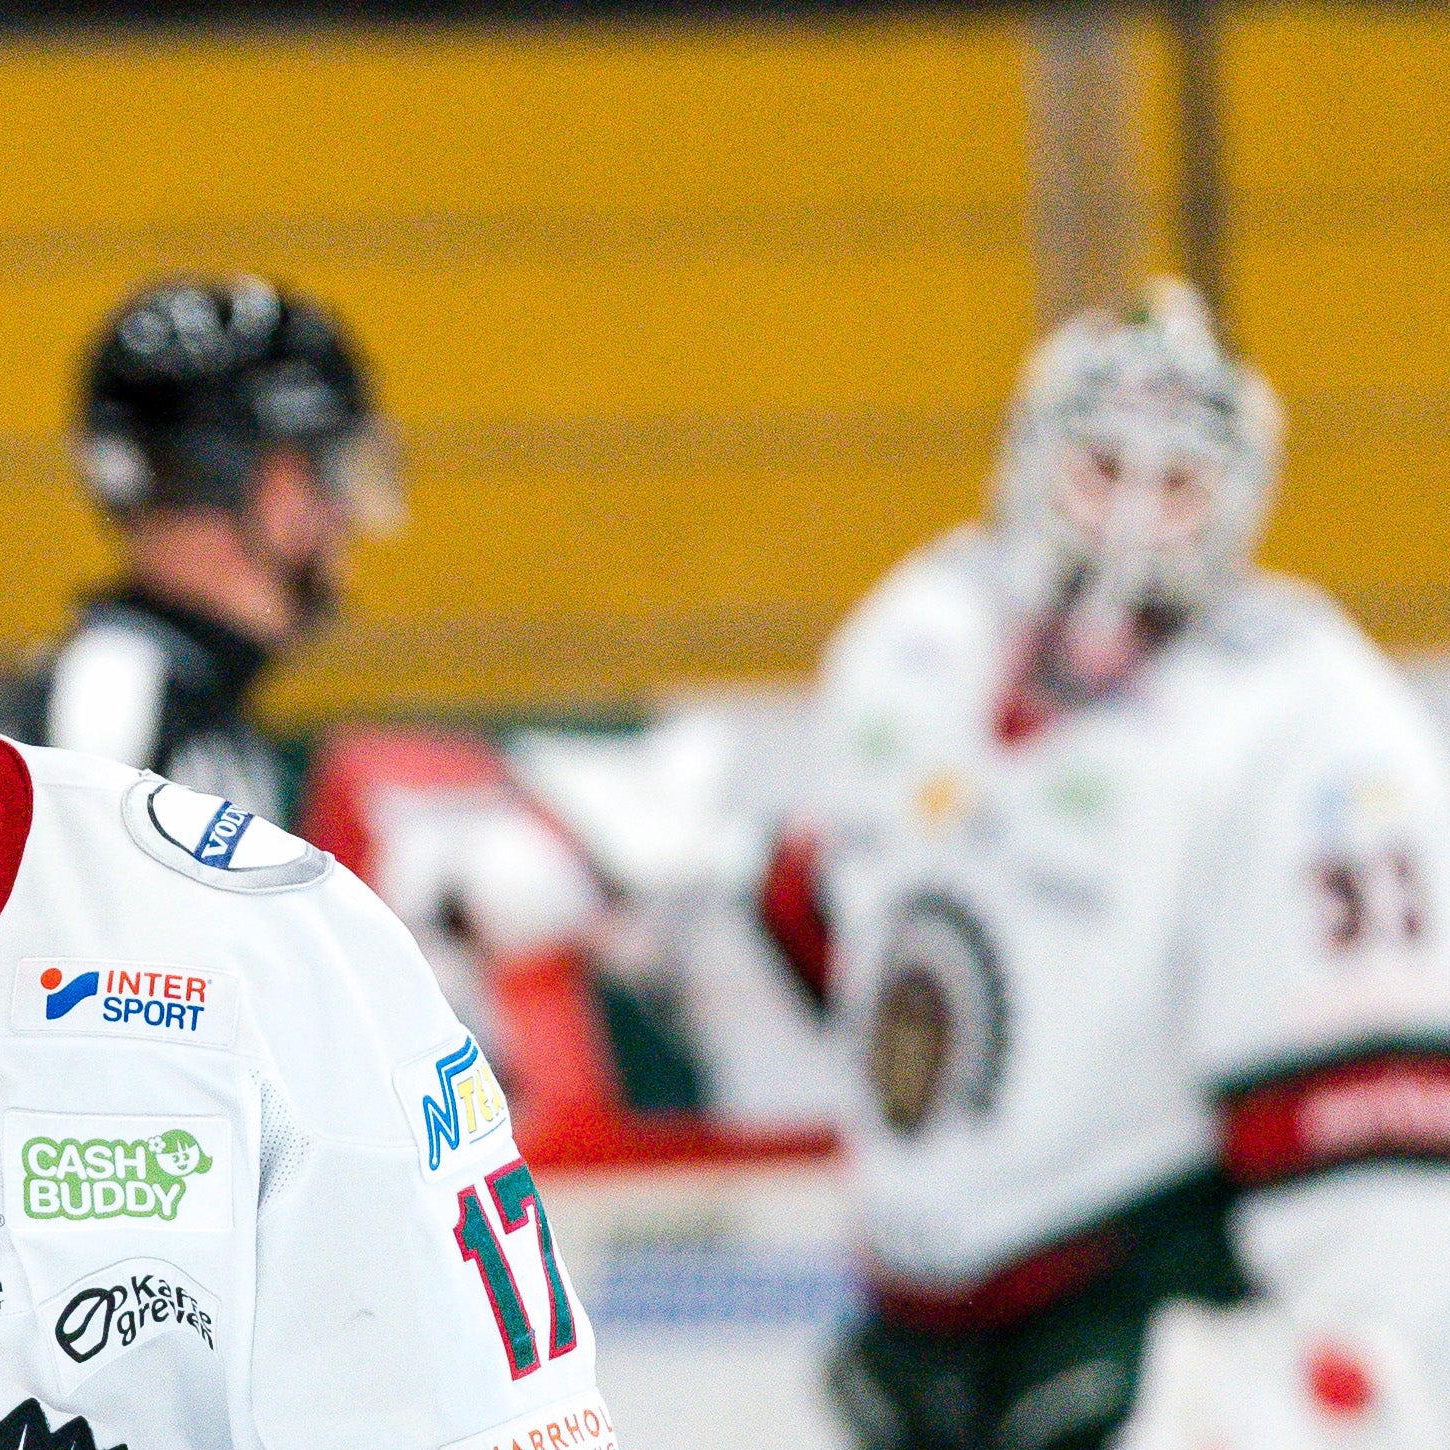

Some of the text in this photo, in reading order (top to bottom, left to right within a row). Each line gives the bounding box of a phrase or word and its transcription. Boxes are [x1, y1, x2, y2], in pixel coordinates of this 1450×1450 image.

[107, 970, 207, 1003] INTER
[103, 996, 204, 1031] SPORT
[27, 1143, 147, 1180] CASH
[29, 1178, 181, 1216] BUDDY
[452, 1158, 577, 1381] 17
